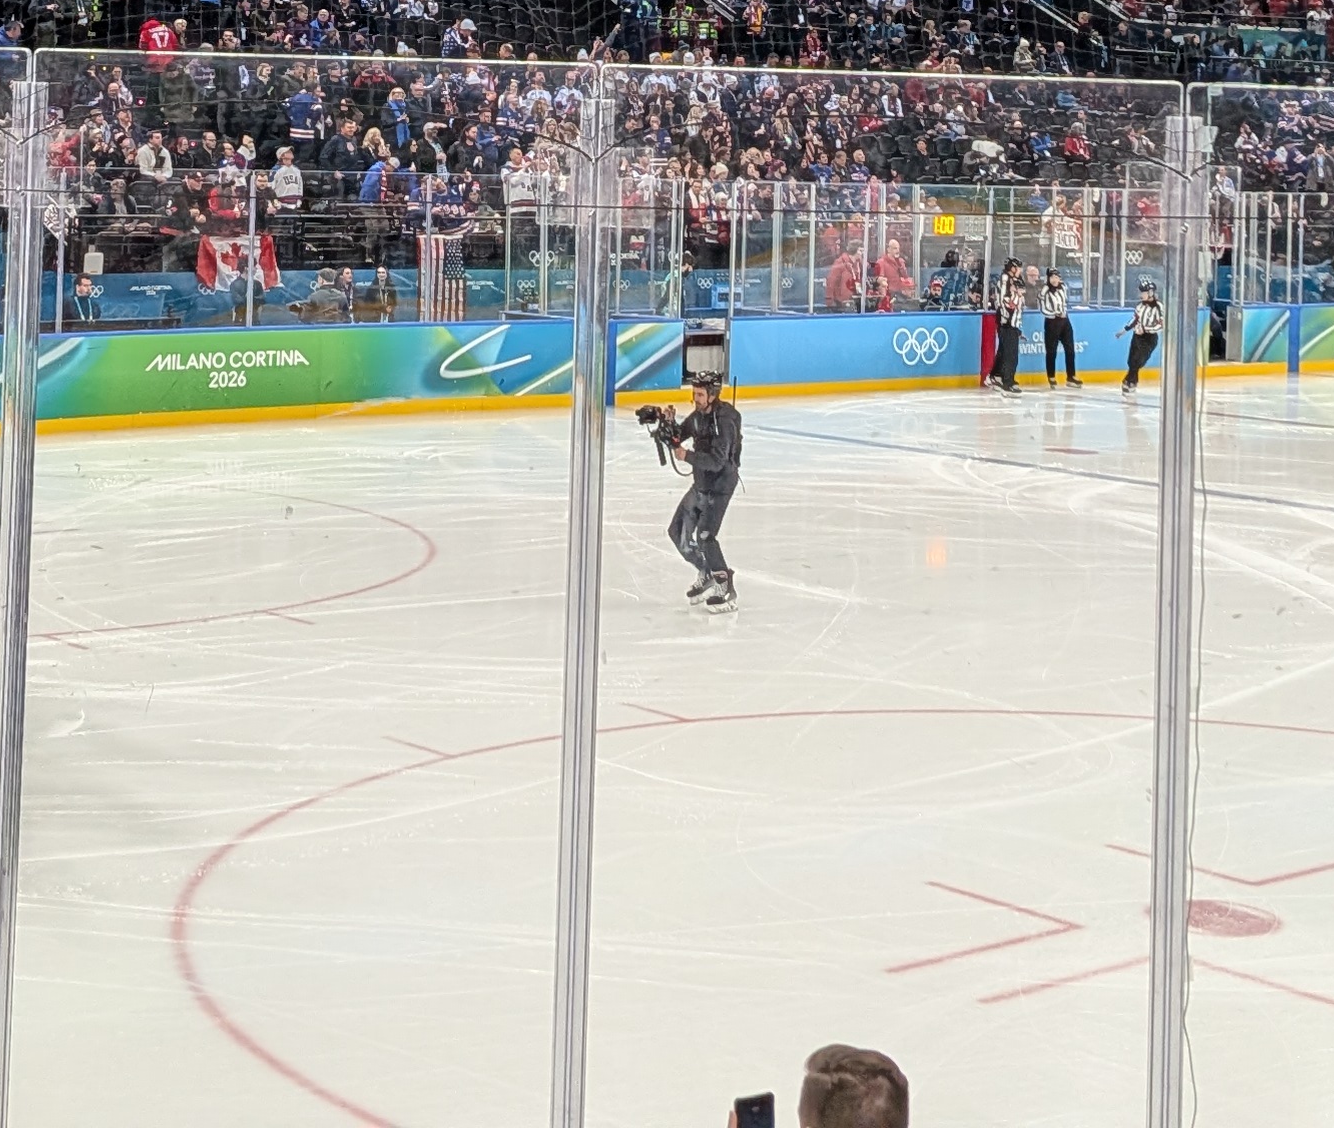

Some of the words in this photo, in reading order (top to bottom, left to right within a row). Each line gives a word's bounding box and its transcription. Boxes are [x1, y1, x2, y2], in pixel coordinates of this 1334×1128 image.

[151, 31, 170, 49] 17
[933, 215, 955, 235] 1:00
[1019, 343, 1046, 355] WINT
[145, 352, 227, 372] MILANO
[229, 349, 310, 369] CORTINA
[208, 371, 247, 389] 2026
